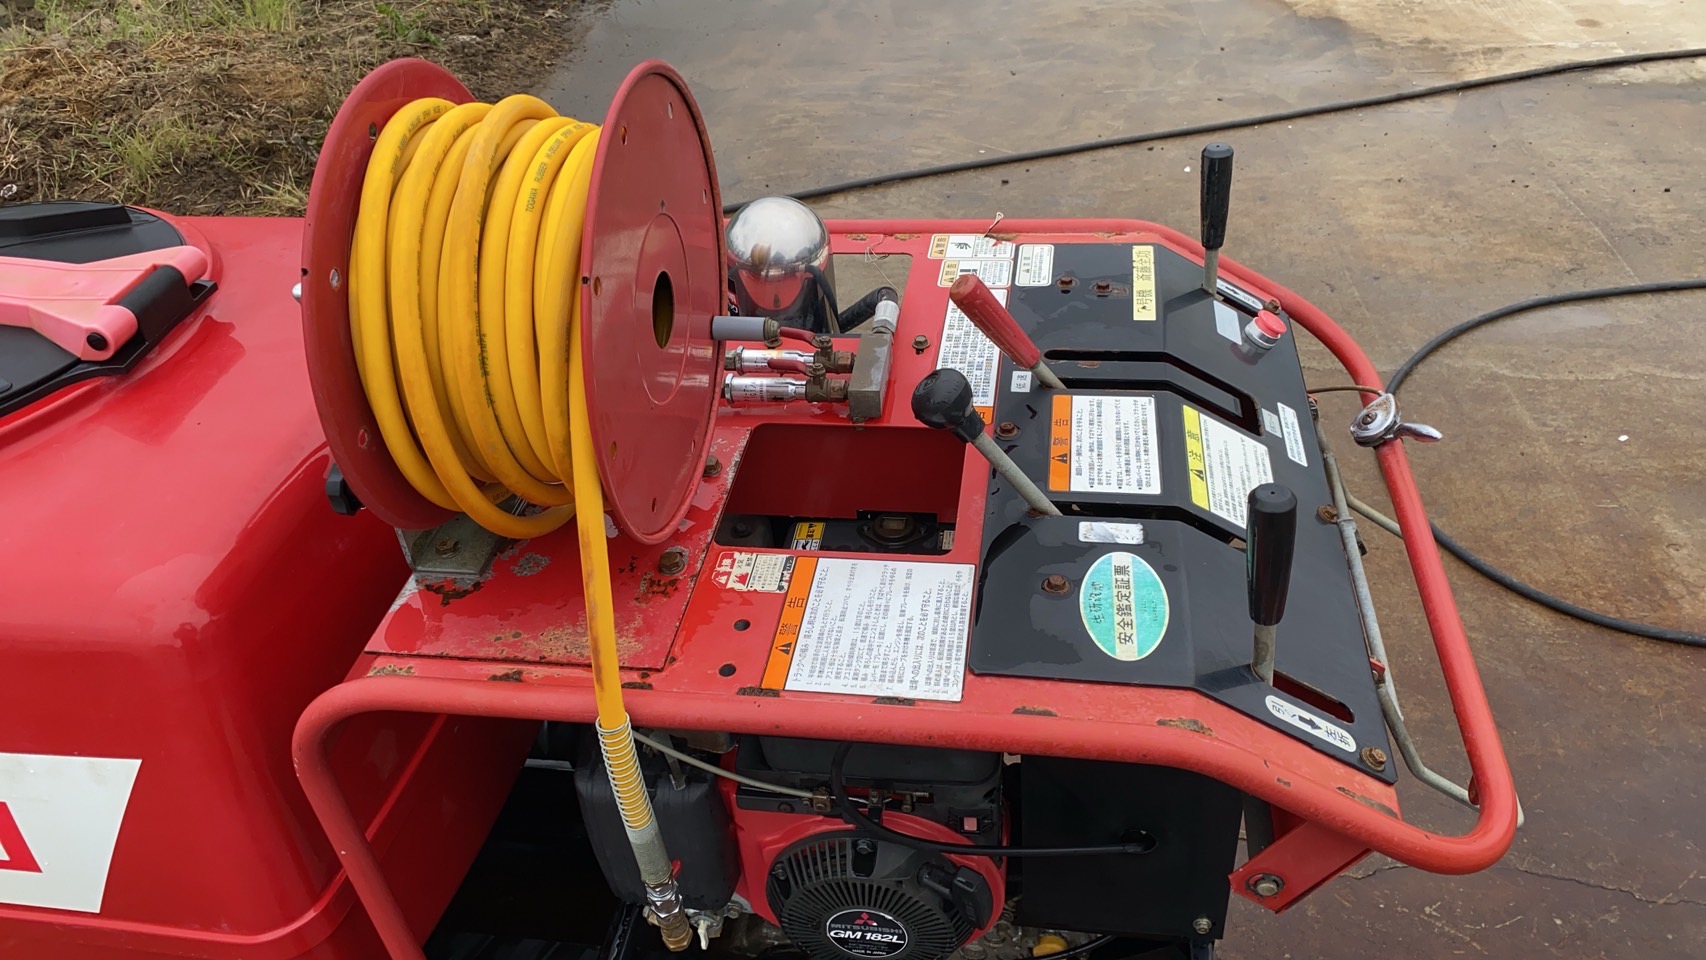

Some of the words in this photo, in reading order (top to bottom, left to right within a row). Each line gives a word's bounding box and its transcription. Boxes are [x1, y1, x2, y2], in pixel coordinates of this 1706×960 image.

[525, 187, 539, 213] TOGAWA
[534, 161, 548, 184] RUBBER
[1052, 418, 1068, 445] 警告
[778, 596, 805, 635] 警告
[1114, 564, 1134, 645] 安全鑑定証票
[830, 923, 902, 934] MITSUBISHI
